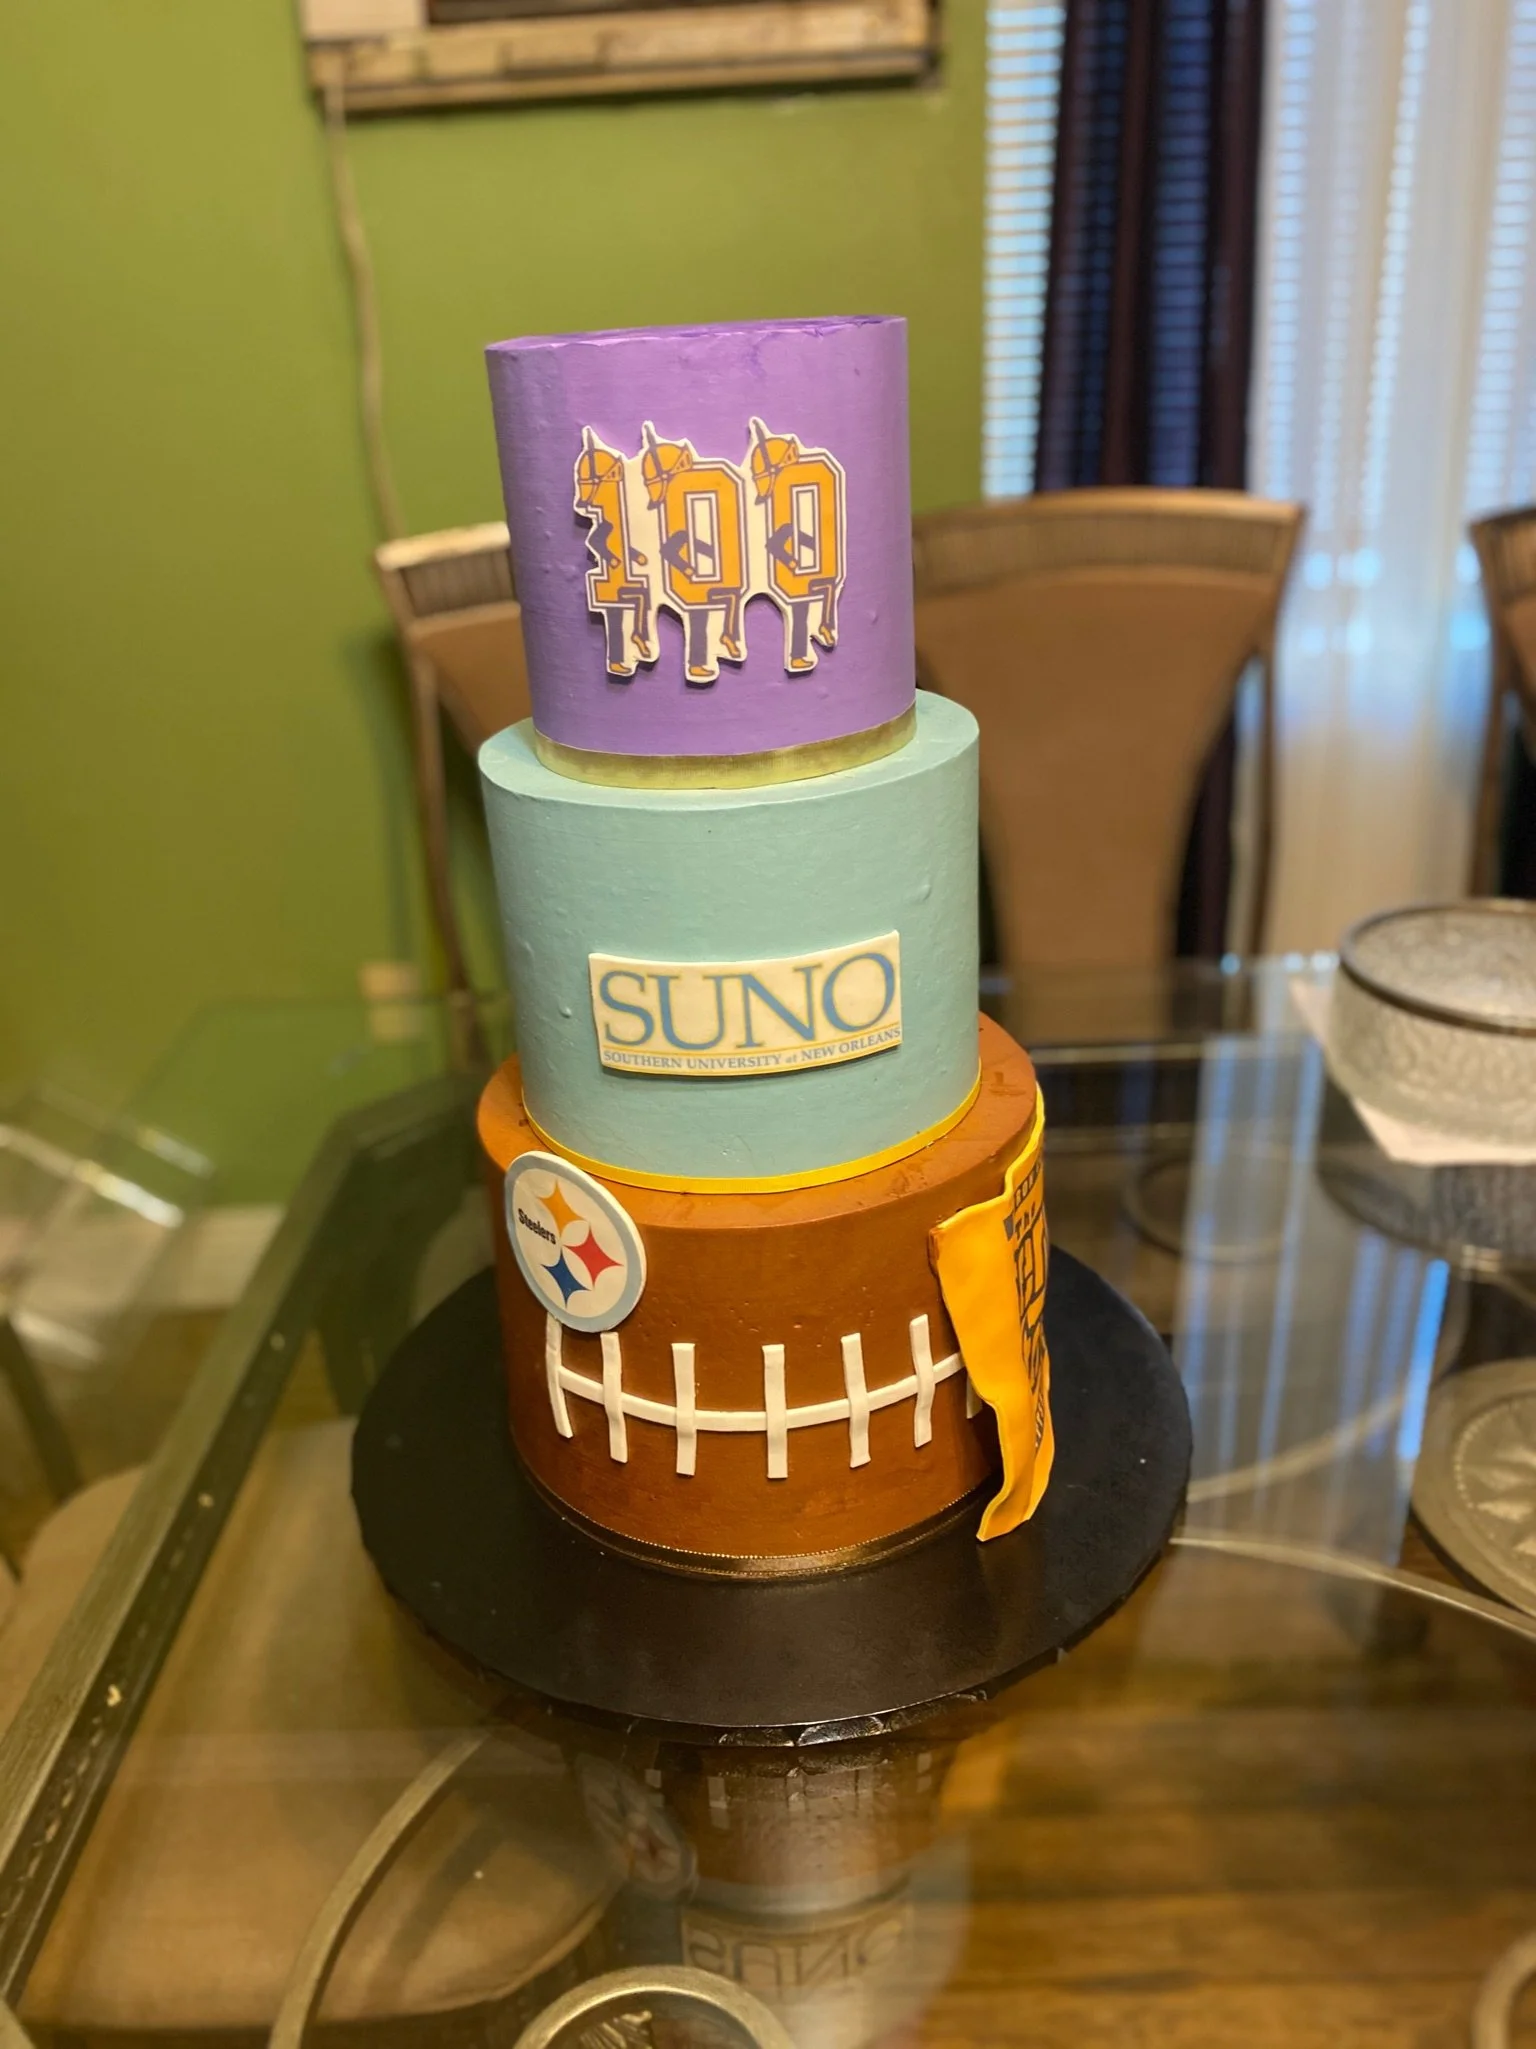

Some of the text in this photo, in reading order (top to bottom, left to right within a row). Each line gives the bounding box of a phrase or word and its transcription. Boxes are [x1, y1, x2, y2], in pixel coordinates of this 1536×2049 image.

[576, 446, 846, 616] 100
[599, 951, 897, 1050] SUNO
[603, 1027, 901, 1069] SOUTHERN UNIVERSITY at NEW ORLEANS
[517, 1208, 557, 1246] Steelers
